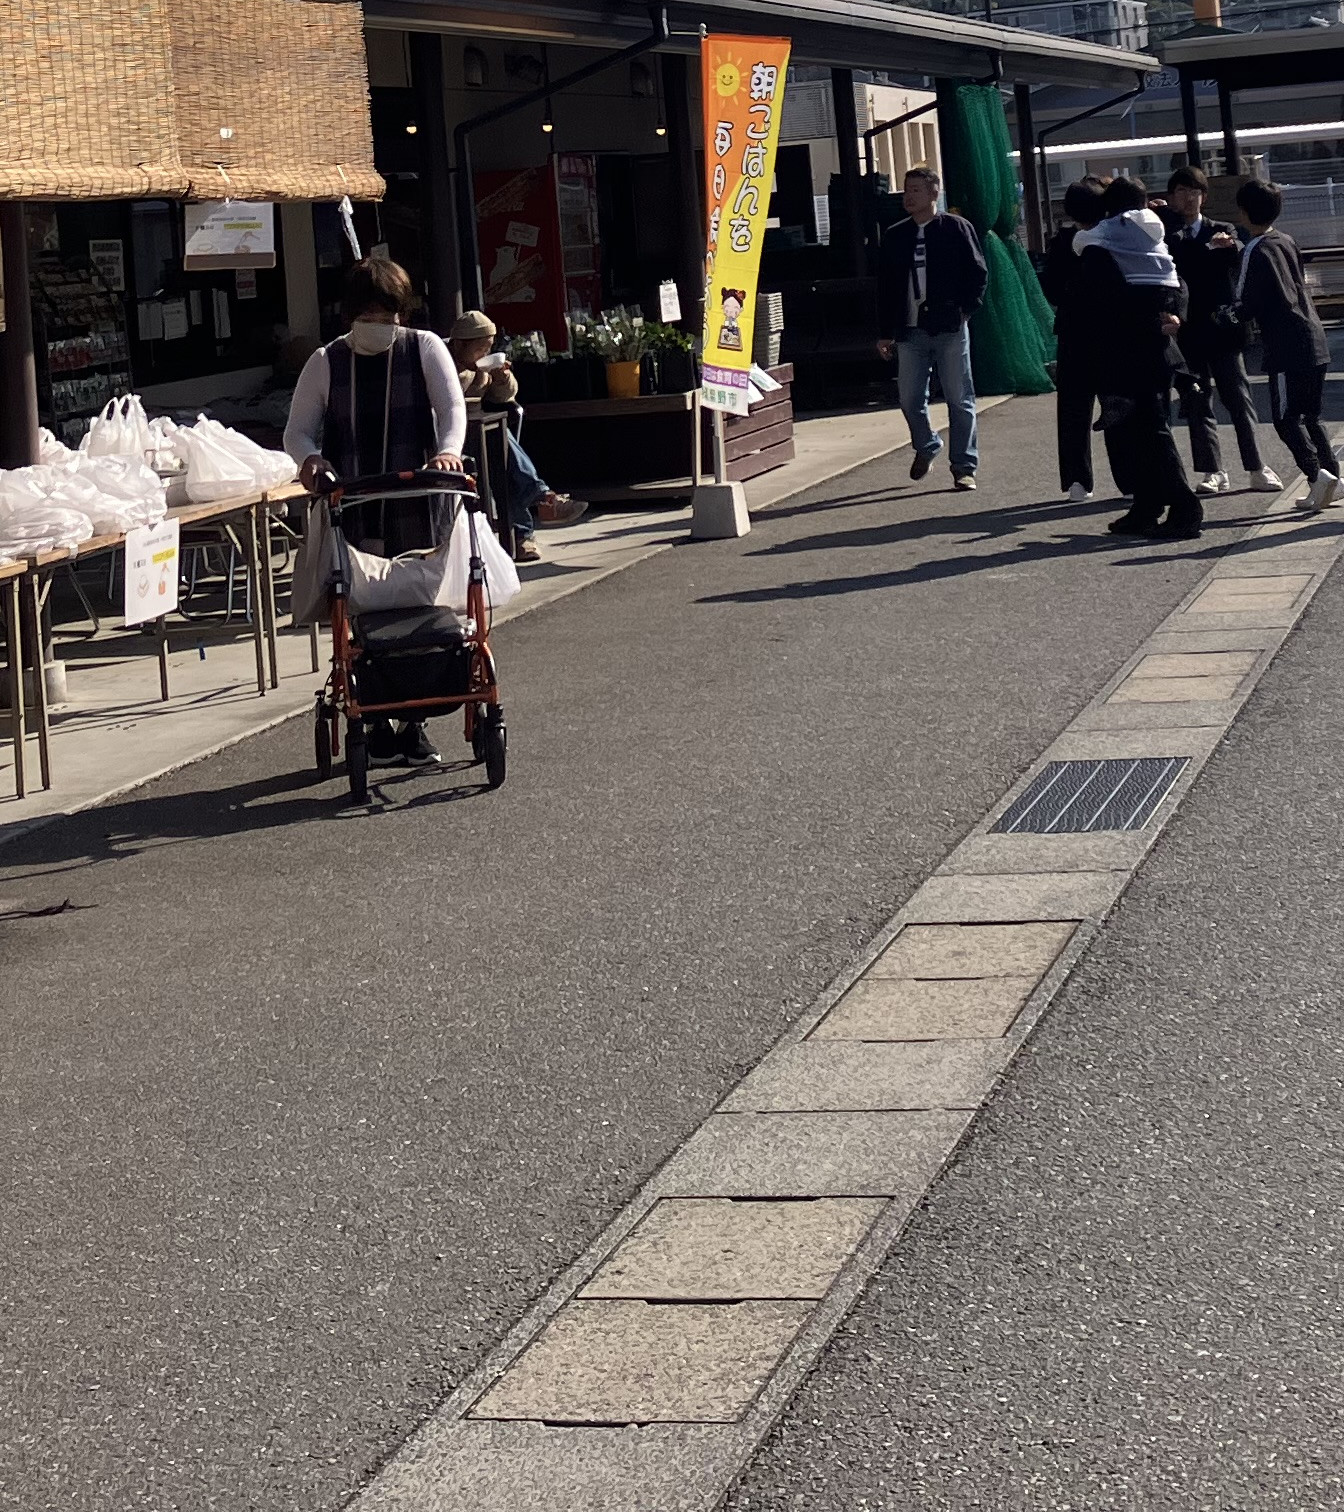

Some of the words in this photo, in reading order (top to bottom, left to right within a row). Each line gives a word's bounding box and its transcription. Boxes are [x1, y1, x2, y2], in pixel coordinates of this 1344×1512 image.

[728, 61, 779, 254] 朝ごはんを
